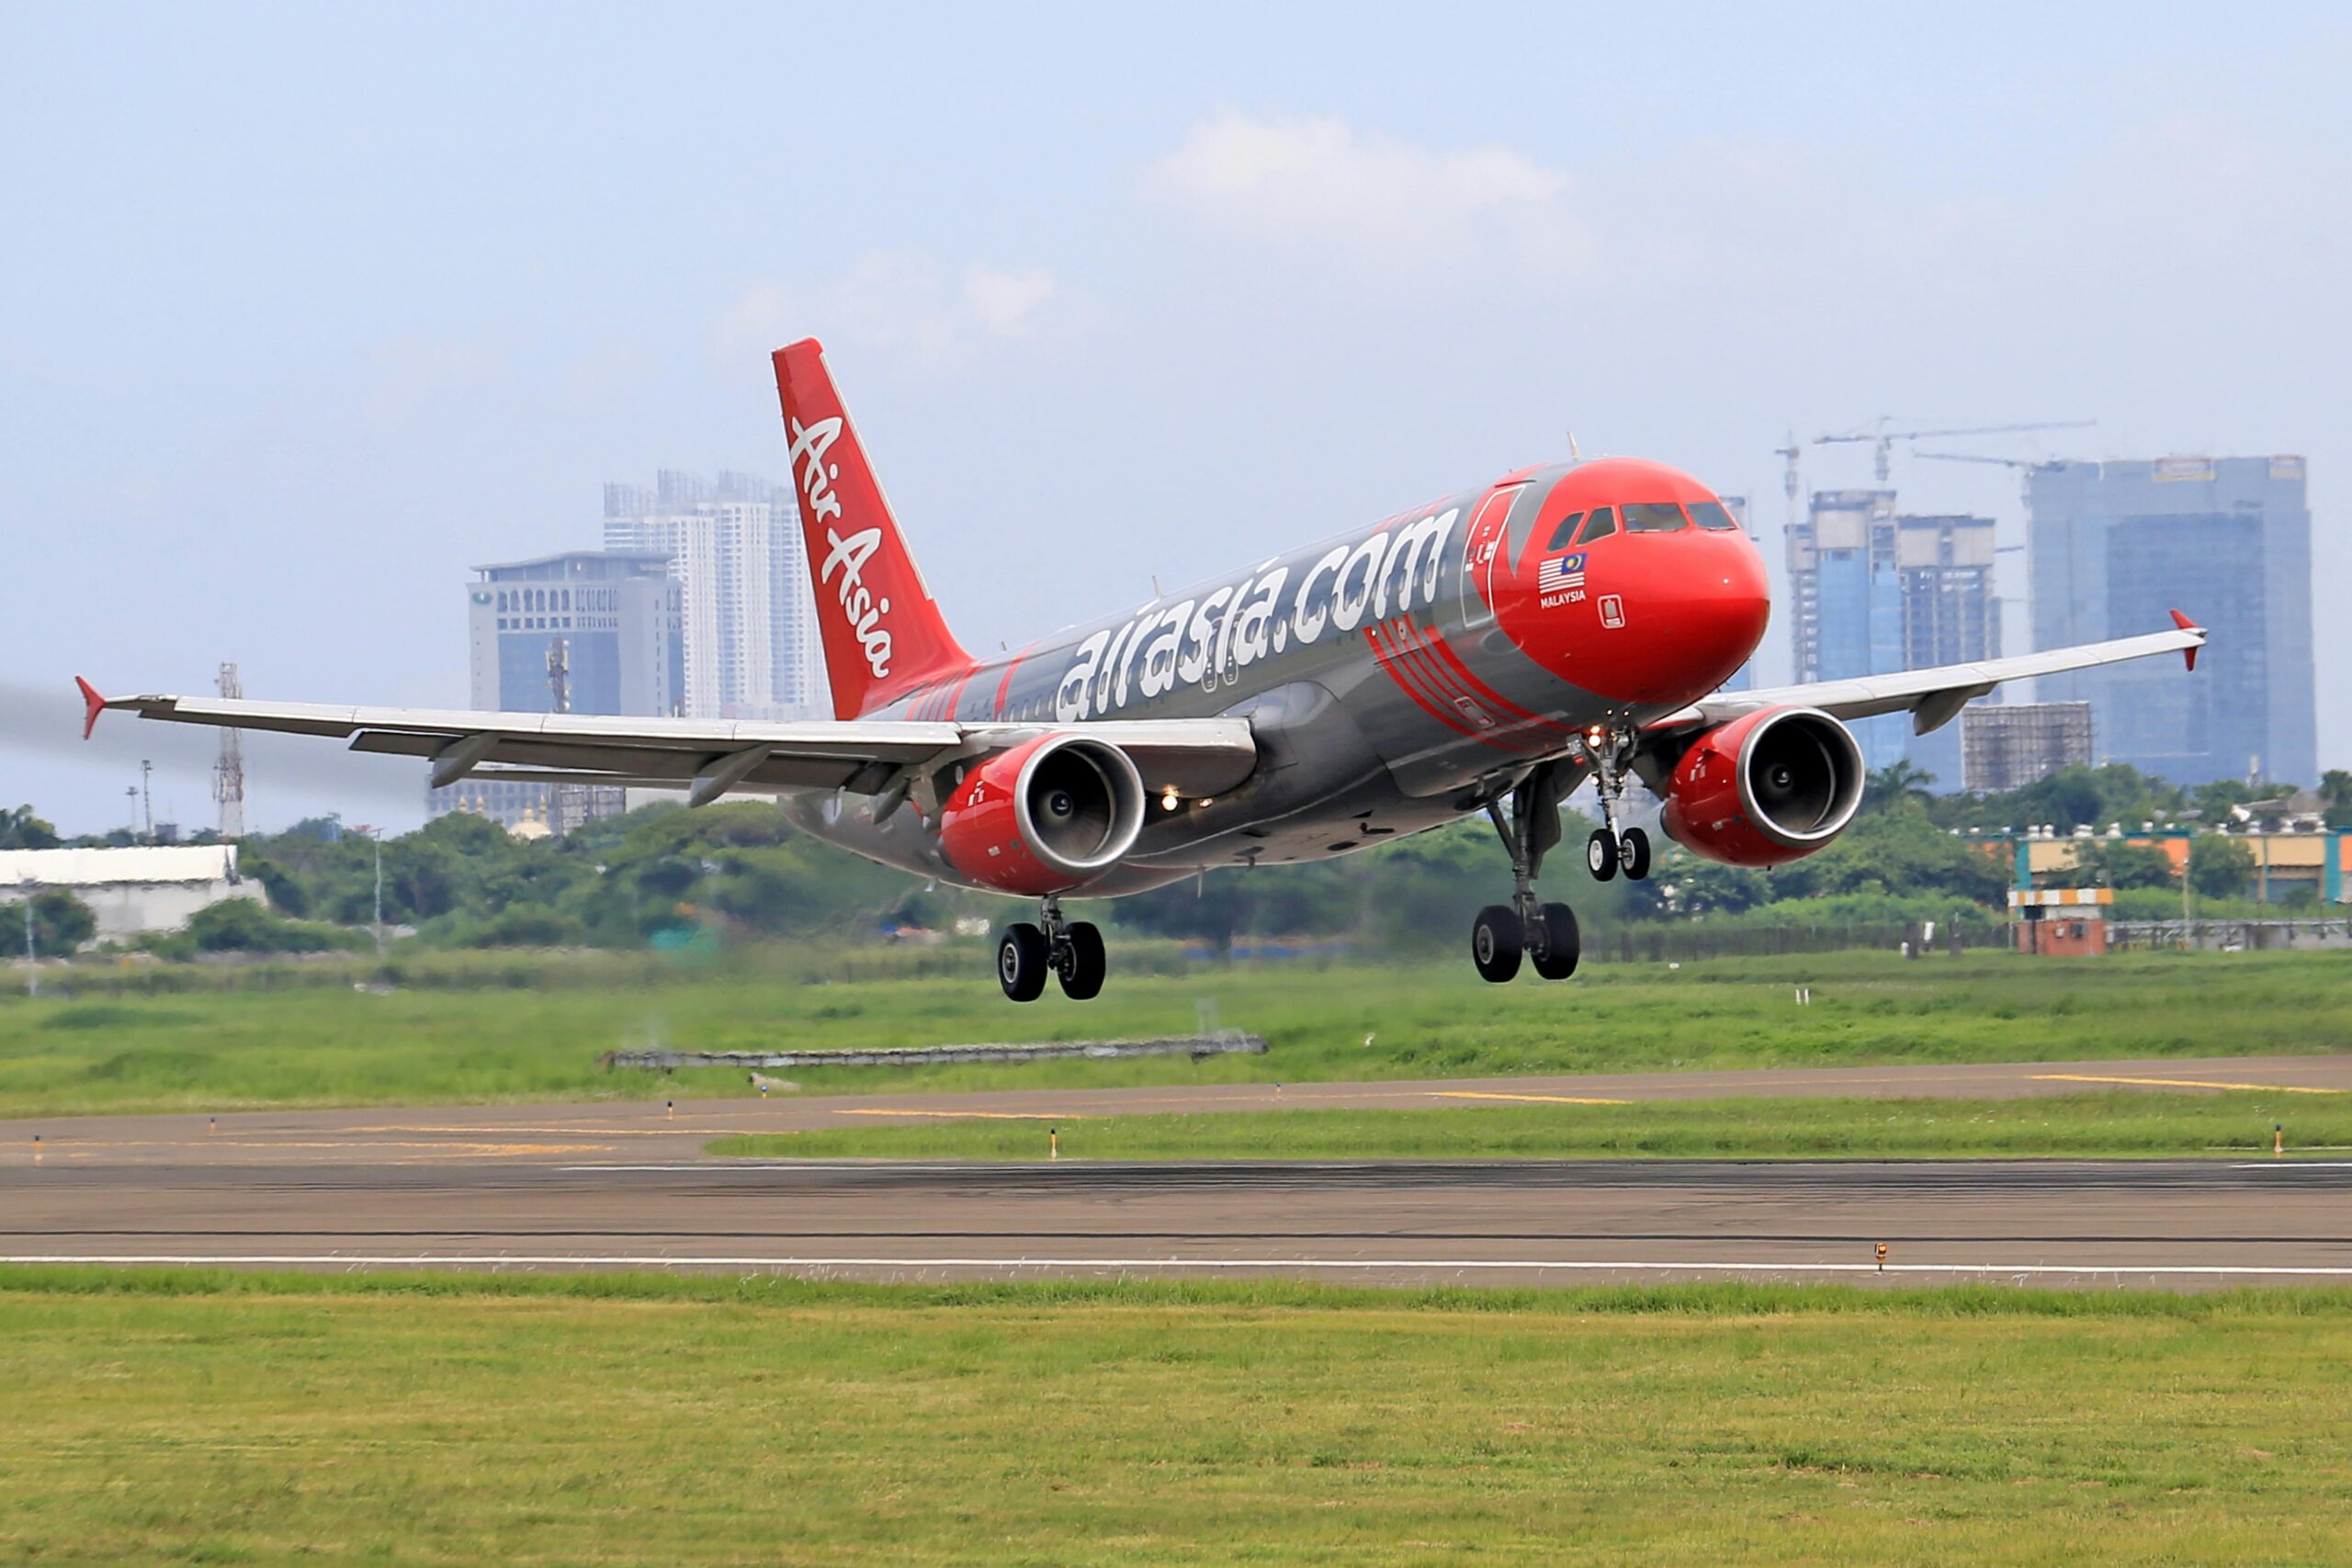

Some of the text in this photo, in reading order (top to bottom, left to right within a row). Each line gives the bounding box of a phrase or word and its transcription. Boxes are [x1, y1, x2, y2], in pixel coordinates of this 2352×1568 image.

[790, 416, 891, 678] Air Asia
[1056, 507, 1459, 723] airasia.com
[1540, 590, 1586, 609] MALAYSIA
